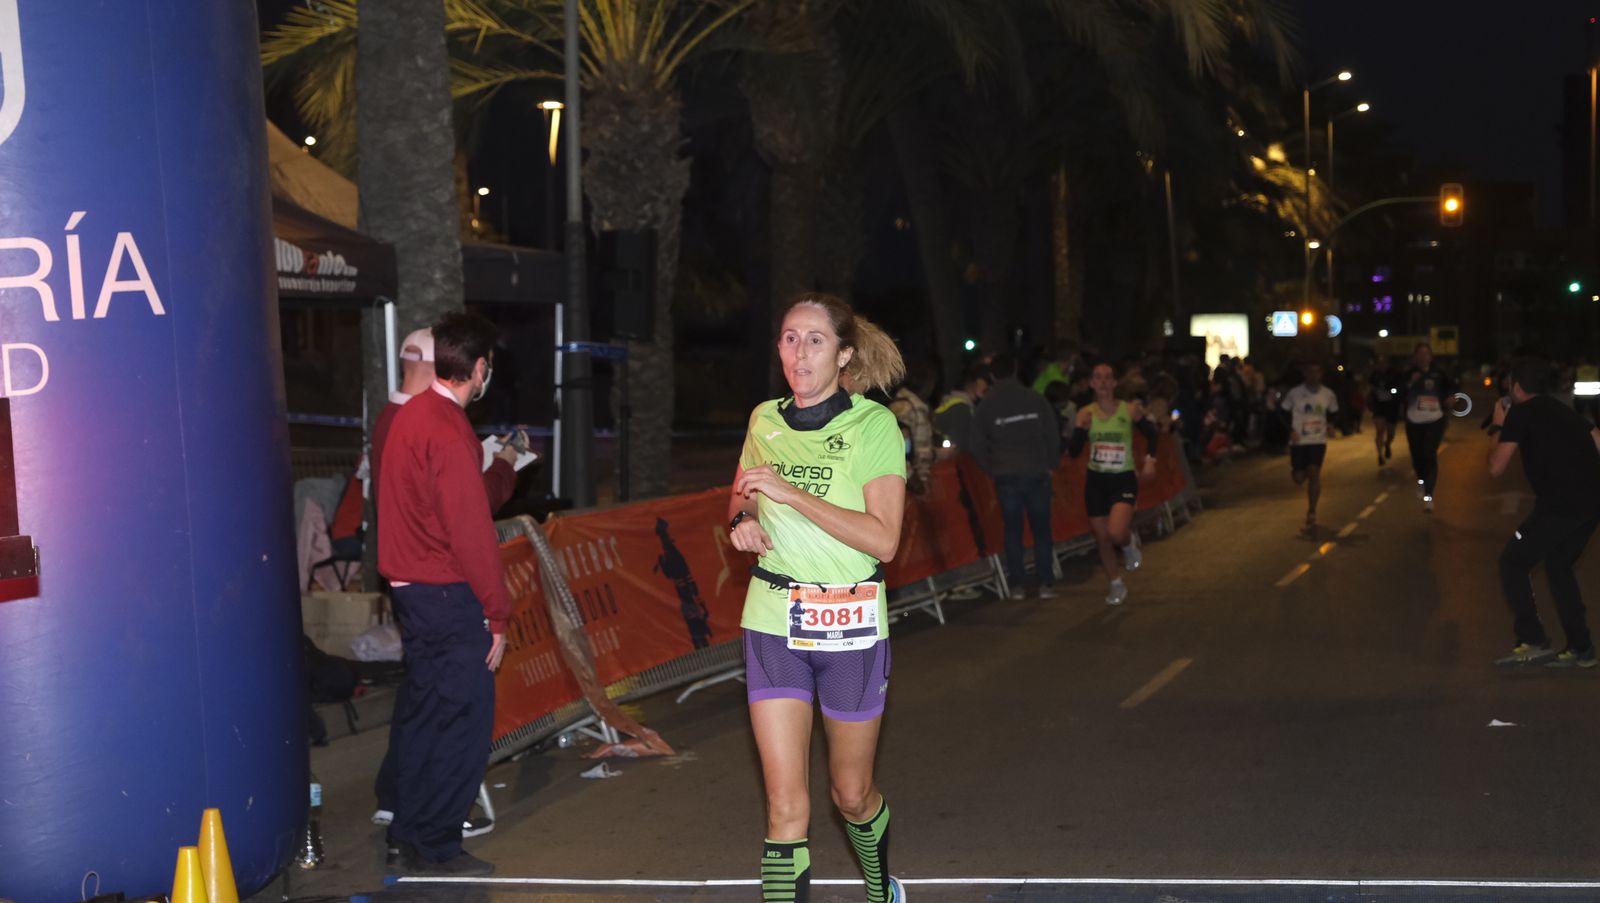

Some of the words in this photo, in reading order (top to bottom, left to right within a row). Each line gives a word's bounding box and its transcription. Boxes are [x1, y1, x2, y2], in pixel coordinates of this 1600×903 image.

[0, 342, 50, 396] D
[789, 481, 831, 498] ning
[804, 606, 863, 626] 3081
